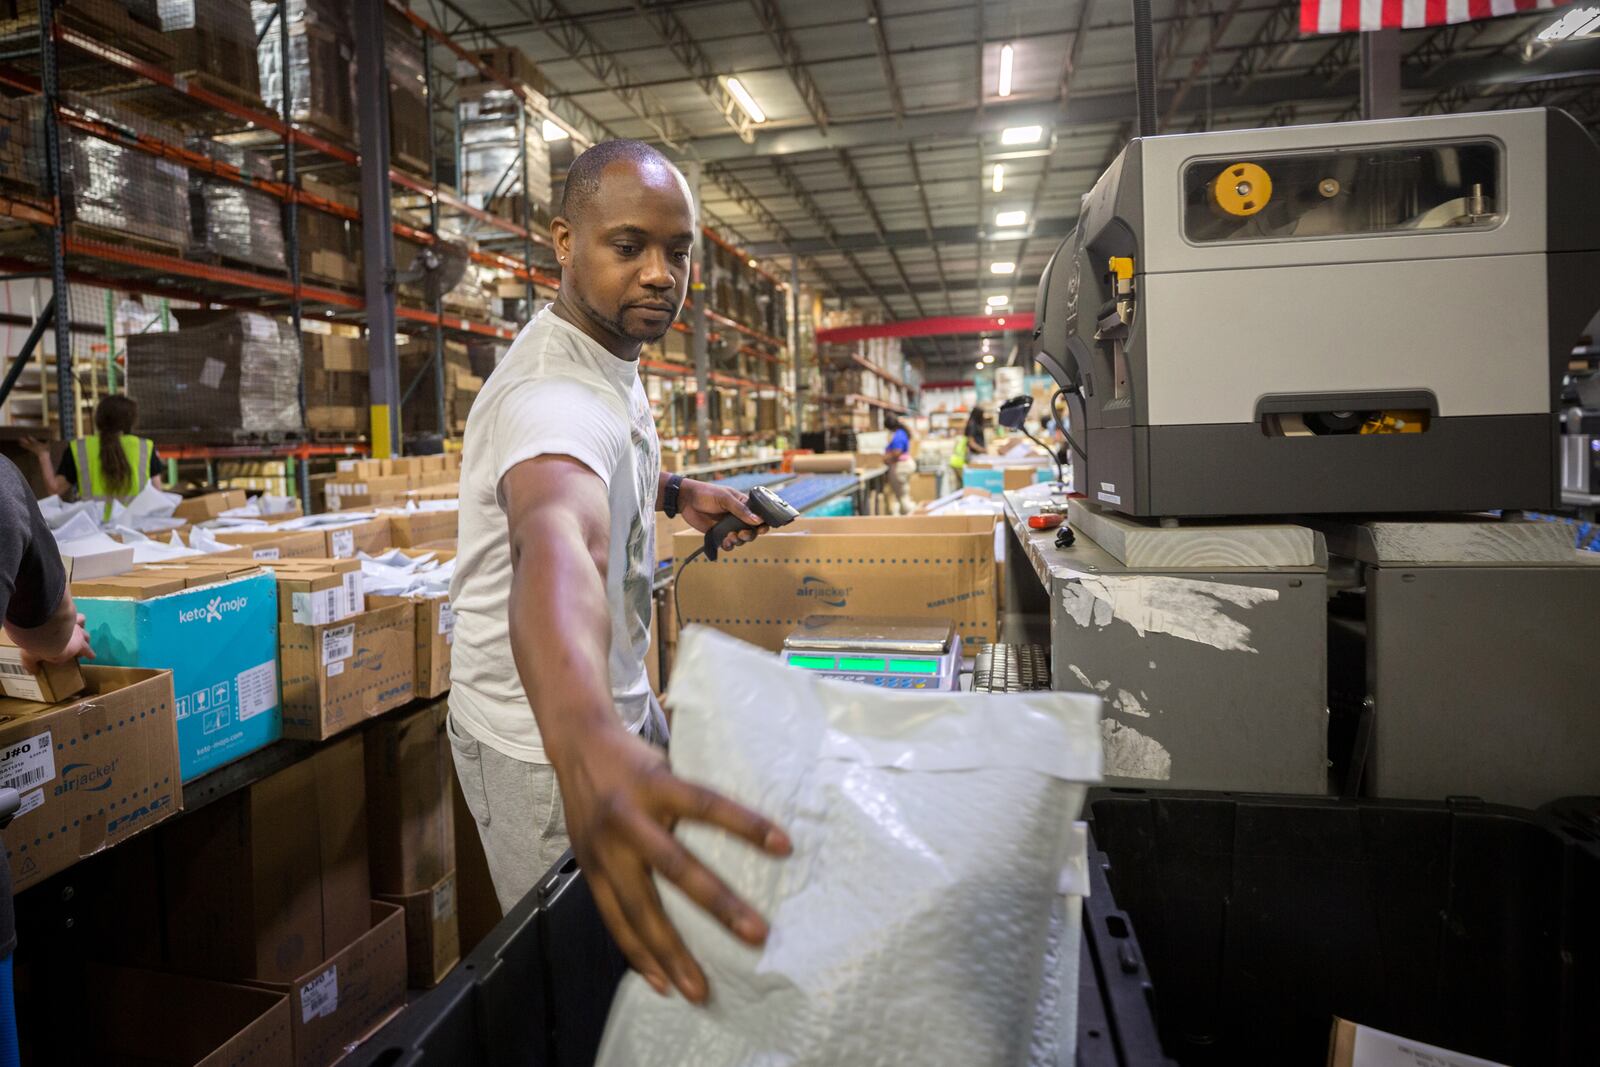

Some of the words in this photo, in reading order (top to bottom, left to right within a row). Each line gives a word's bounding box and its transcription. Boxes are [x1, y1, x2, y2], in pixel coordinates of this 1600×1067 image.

[796, 587, 852, 599] airjacket
[1, 743, 31, 761] J#0
[54, 758, 117, 797] airjacket
